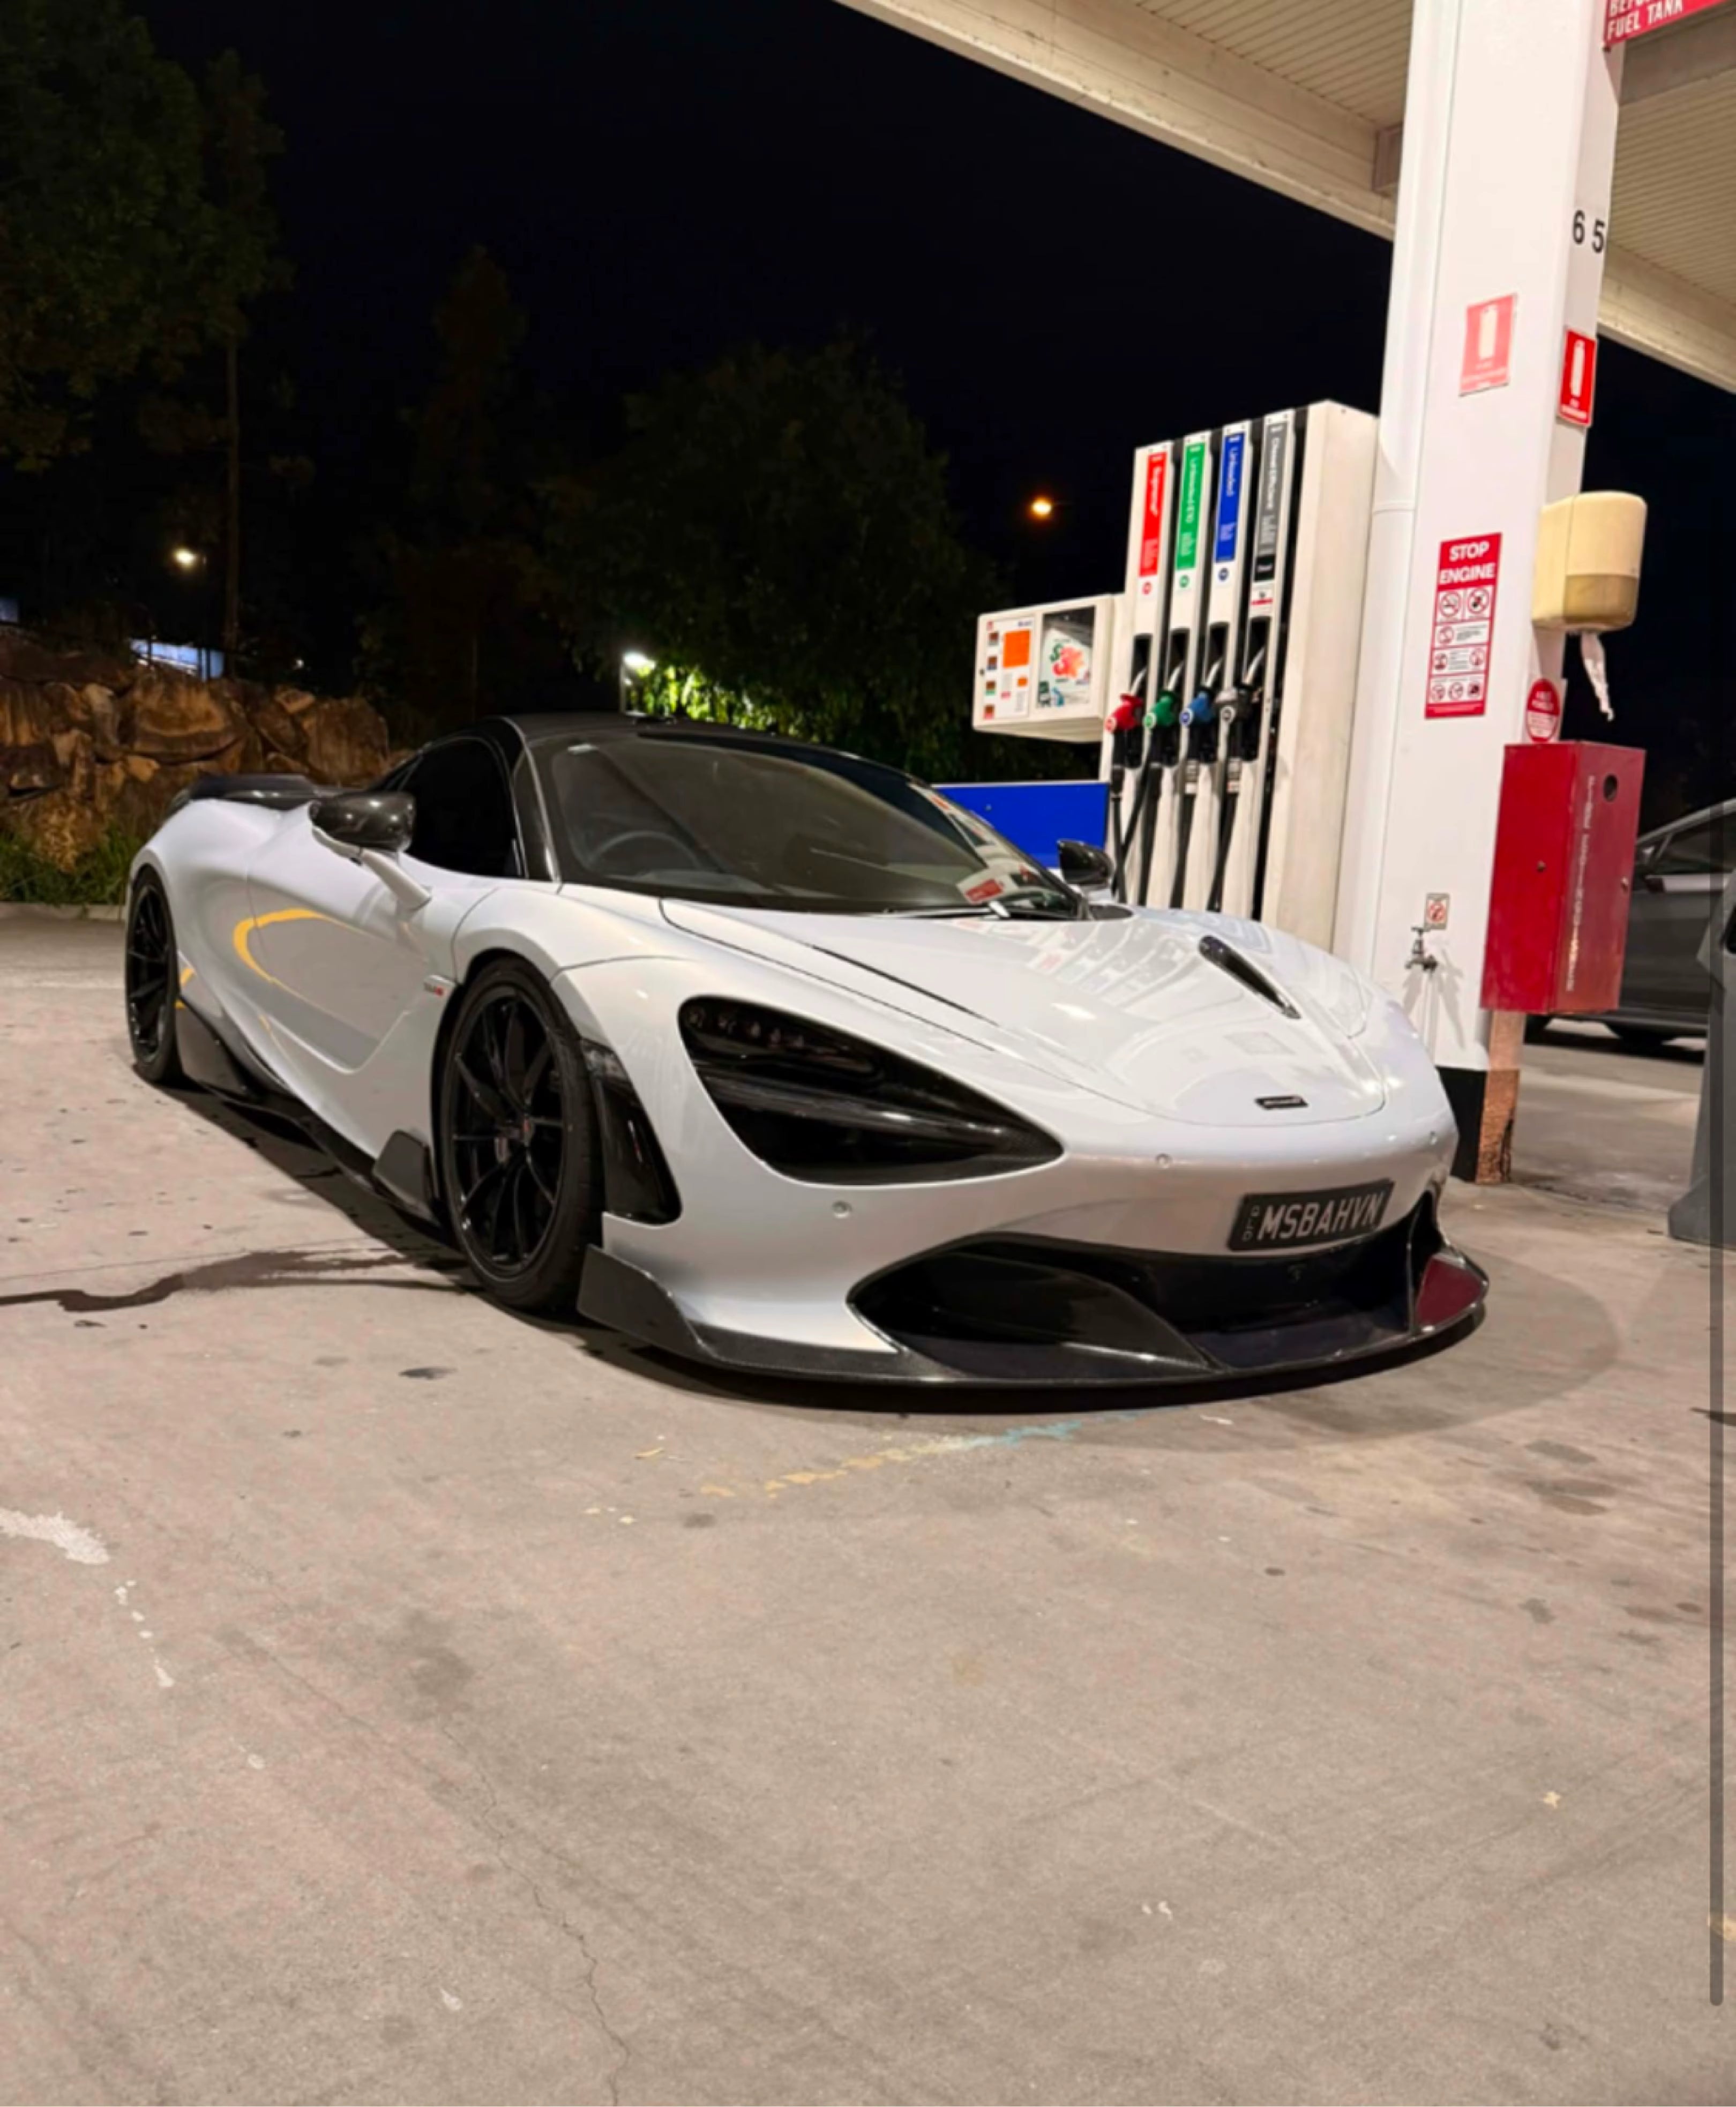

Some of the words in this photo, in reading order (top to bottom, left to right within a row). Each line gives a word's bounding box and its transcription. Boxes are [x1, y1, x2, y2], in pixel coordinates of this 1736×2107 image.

[1607, 11, 1641, 40] FUEL
[1647, 0, 1683, 25] TANK
[1572, 210, 1586, 244] 6
[1591, 219, 1606, 254] 5
[1449, 541, 1490, 562] STOP
[1440, 562, 1496, 584] ENGINE
[1257, 1191, 1385, 1241] MSBAHVN
